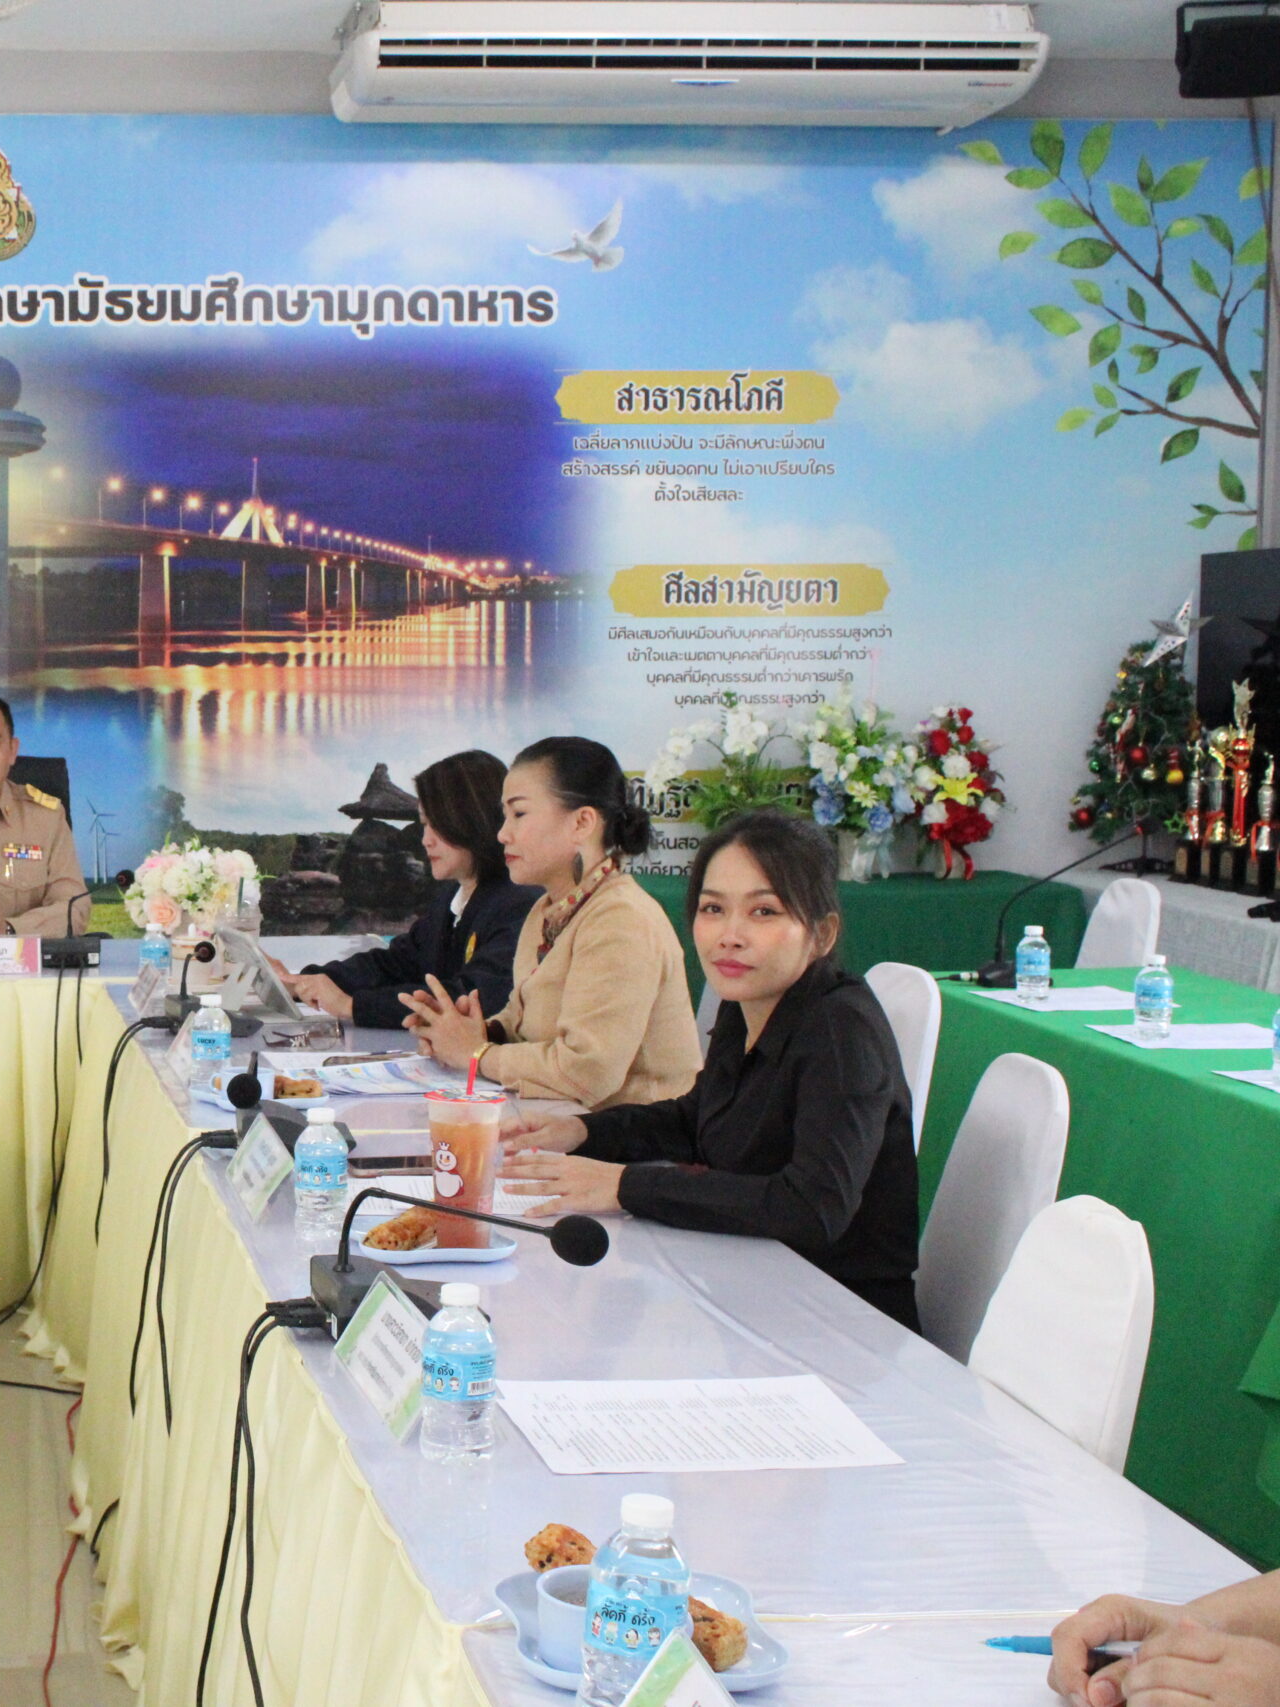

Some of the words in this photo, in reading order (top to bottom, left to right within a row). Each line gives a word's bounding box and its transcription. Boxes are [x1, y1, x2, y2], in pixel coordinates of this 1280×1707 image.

[617, 373, 784, 412] สาธารณโภคี
[562, 459, 640, 476] สร้างสรรค์
[646, 459, 718, 476] ขยันอดทน
[723, 458, 835, 476] ไม่เอาเปรียบใคร
[654, 482, 744, 501] ตั้งใจเสียสละ
